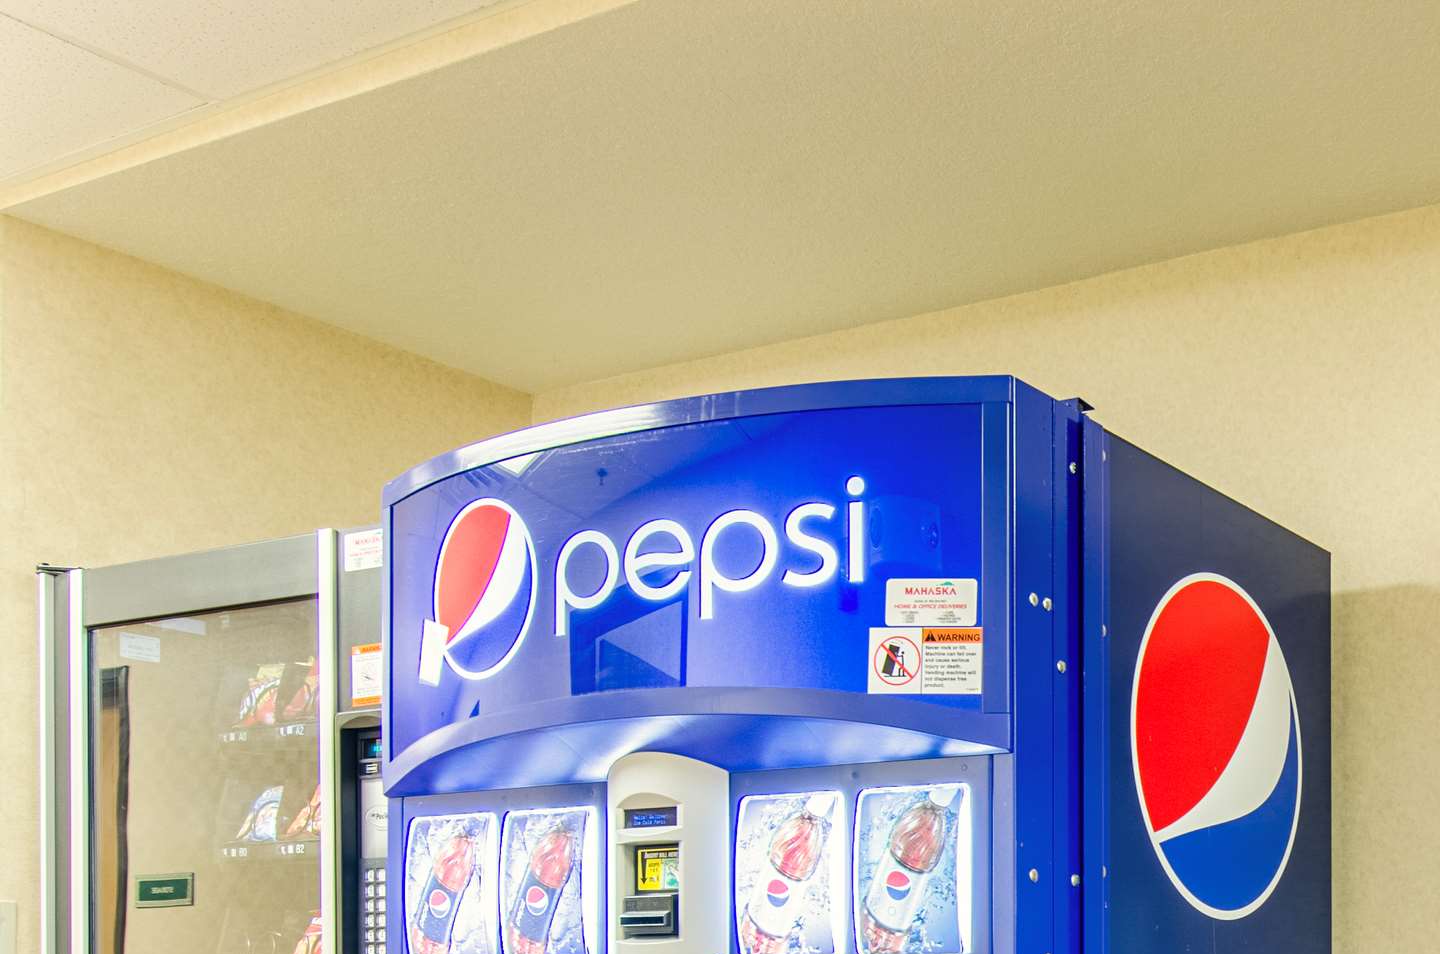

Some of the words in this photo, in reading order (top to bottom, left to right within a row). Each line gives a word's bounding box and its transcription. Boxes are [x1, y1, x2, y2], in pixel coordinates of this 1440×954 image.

[552, 475, 866, 637] pepsi
[904, 587, 957, 596] MAHASKA
[937, 633, 981, 642] WARNING
